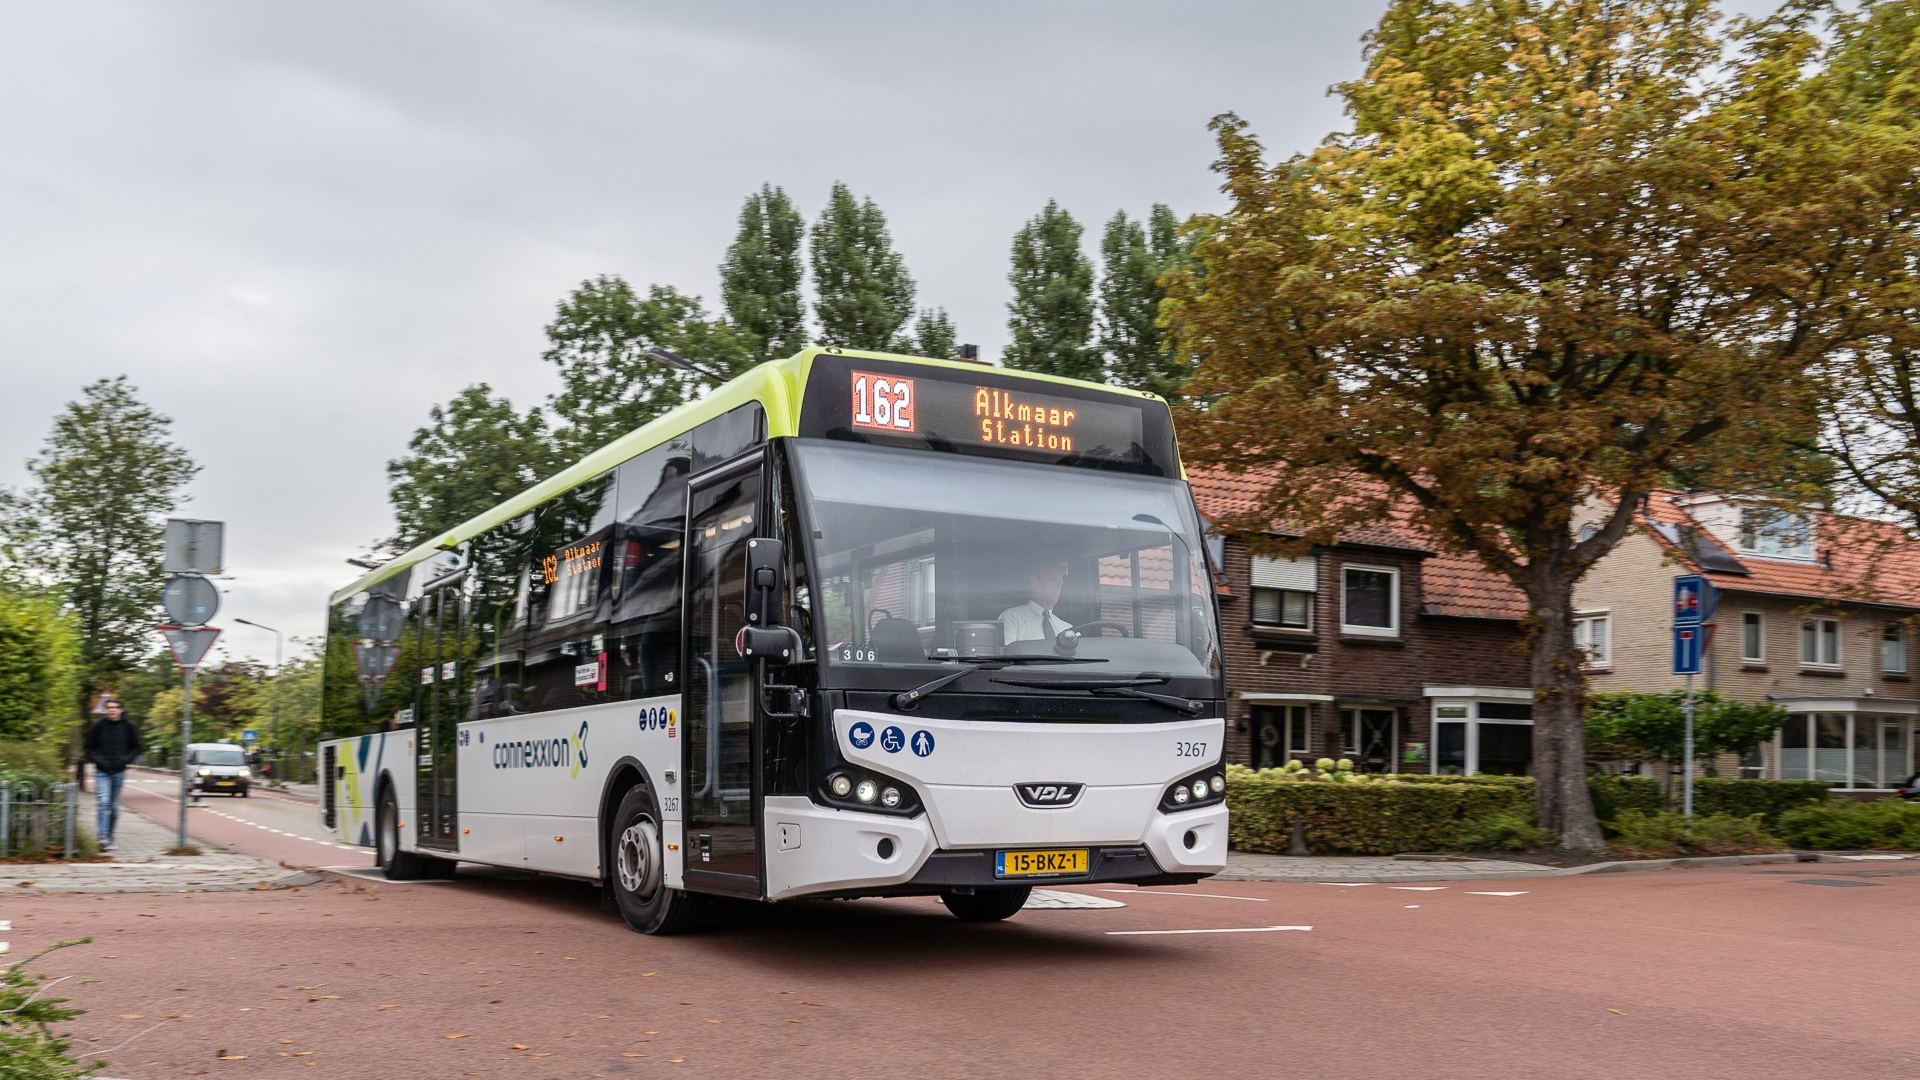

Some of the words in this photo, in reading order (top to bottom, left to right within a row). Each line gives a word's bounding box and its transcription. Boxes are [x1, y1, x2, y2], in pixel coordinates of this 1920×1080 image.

[855, 376, 911, 428] 162
[976, 387, 1075, 427] Alkmaar
[982, 418, 1071, 451] Station
[564, 541, 601, 562] Alkmaar
[493, 738, 570, 770] connexxion
[1176, 741, 1207, 757] 3267
[1025, 786, 1073, 801] VDL
[664, 797, 679, 812] 3267
[1013, 853, 1077, 871] 15-BKZ-1
